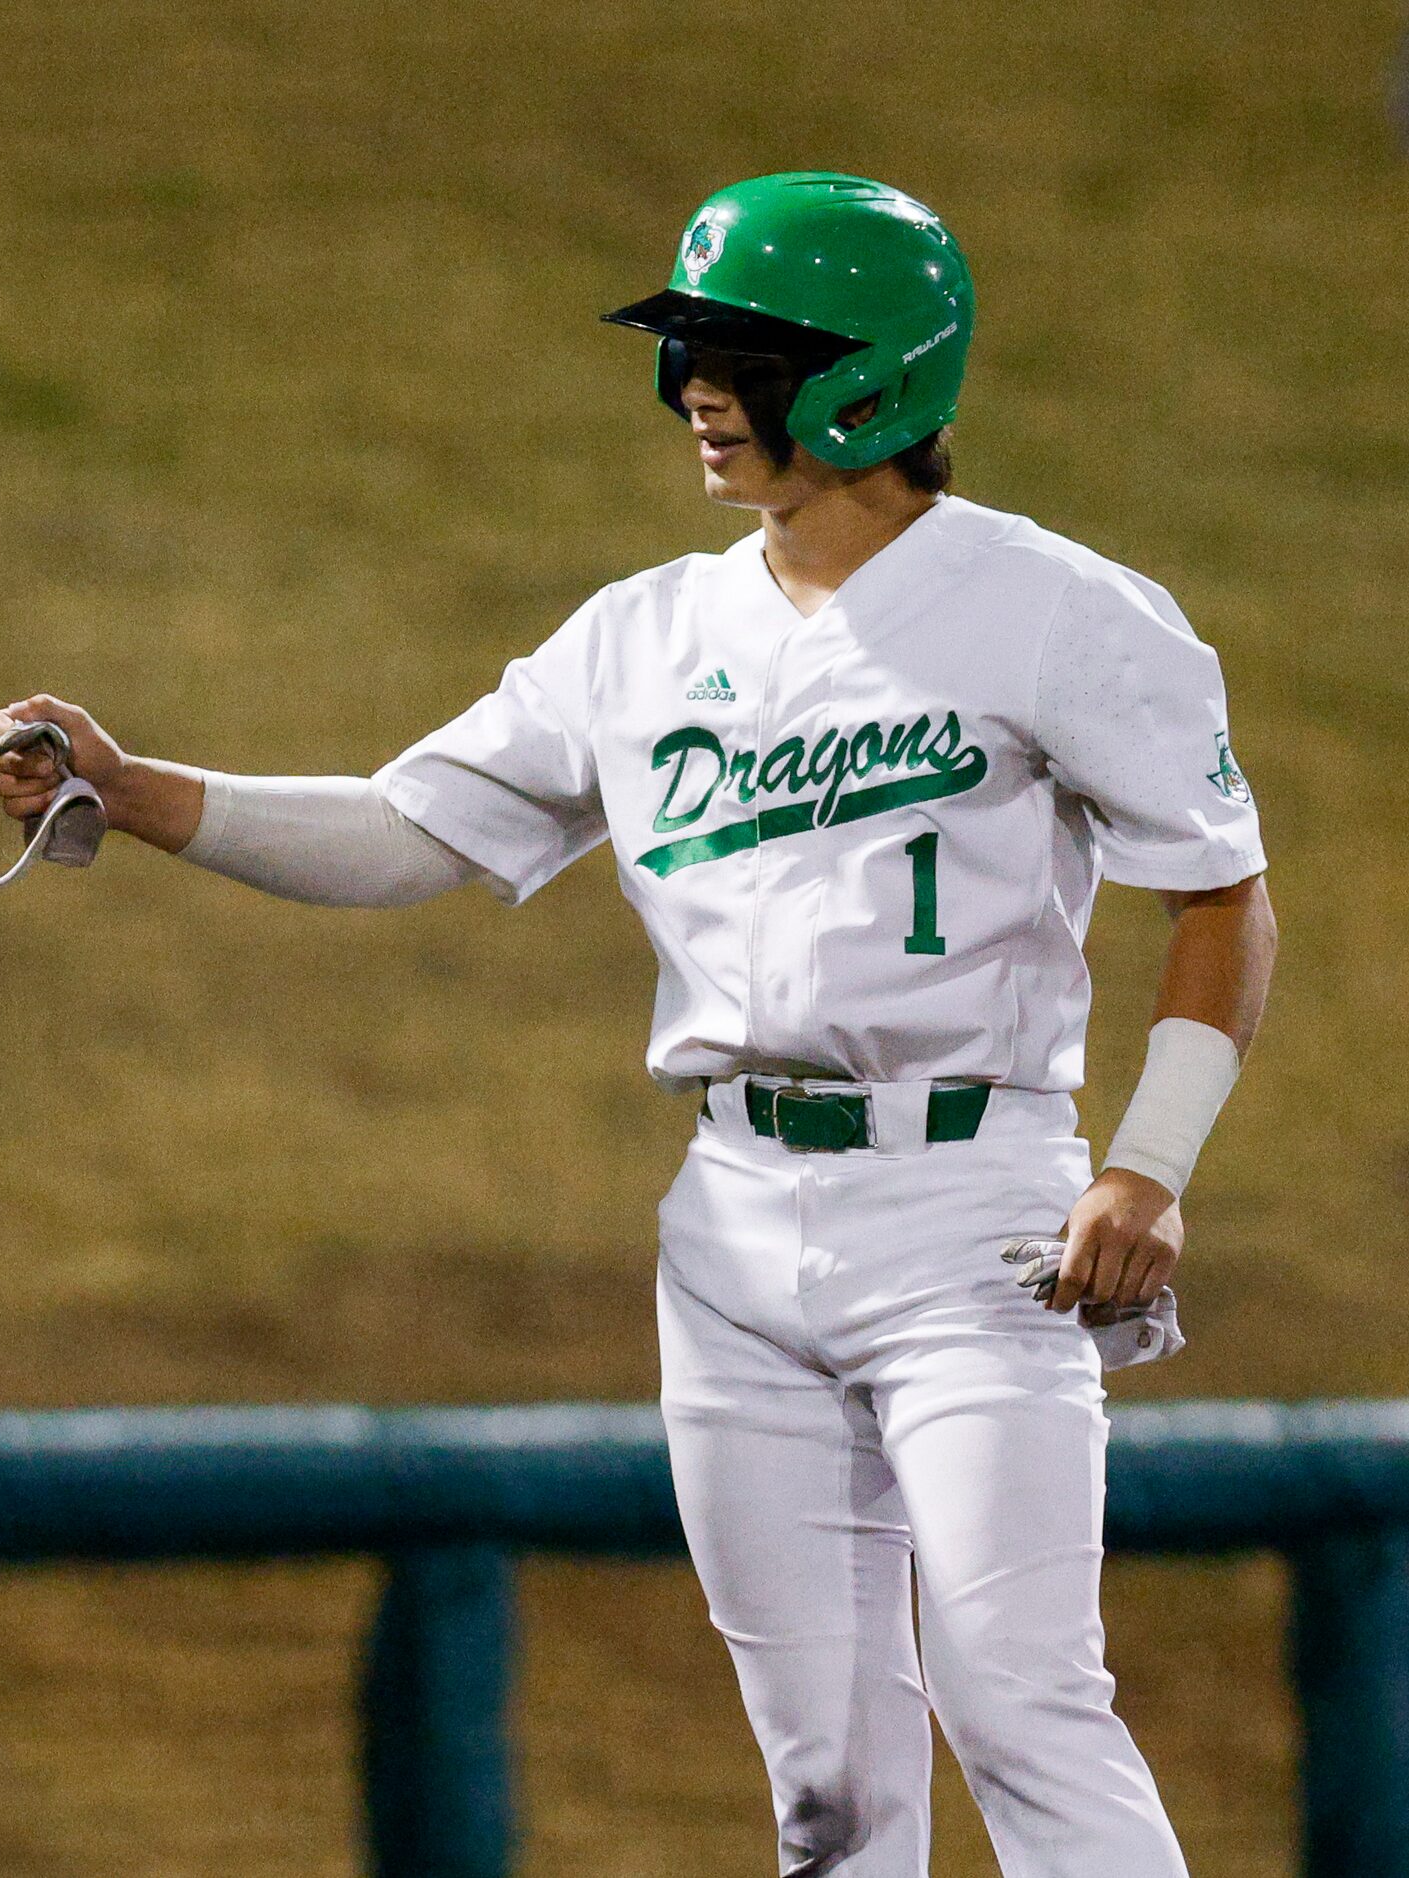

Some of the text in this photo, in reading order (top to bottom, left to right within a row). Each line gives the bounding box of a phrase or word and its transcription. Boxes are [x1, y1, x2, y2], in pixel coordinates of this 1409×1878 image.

[687, 687, 736, 701] adidas
[651, 710, 982, 832] Dragons
[904, 832, 946, 955] 1
